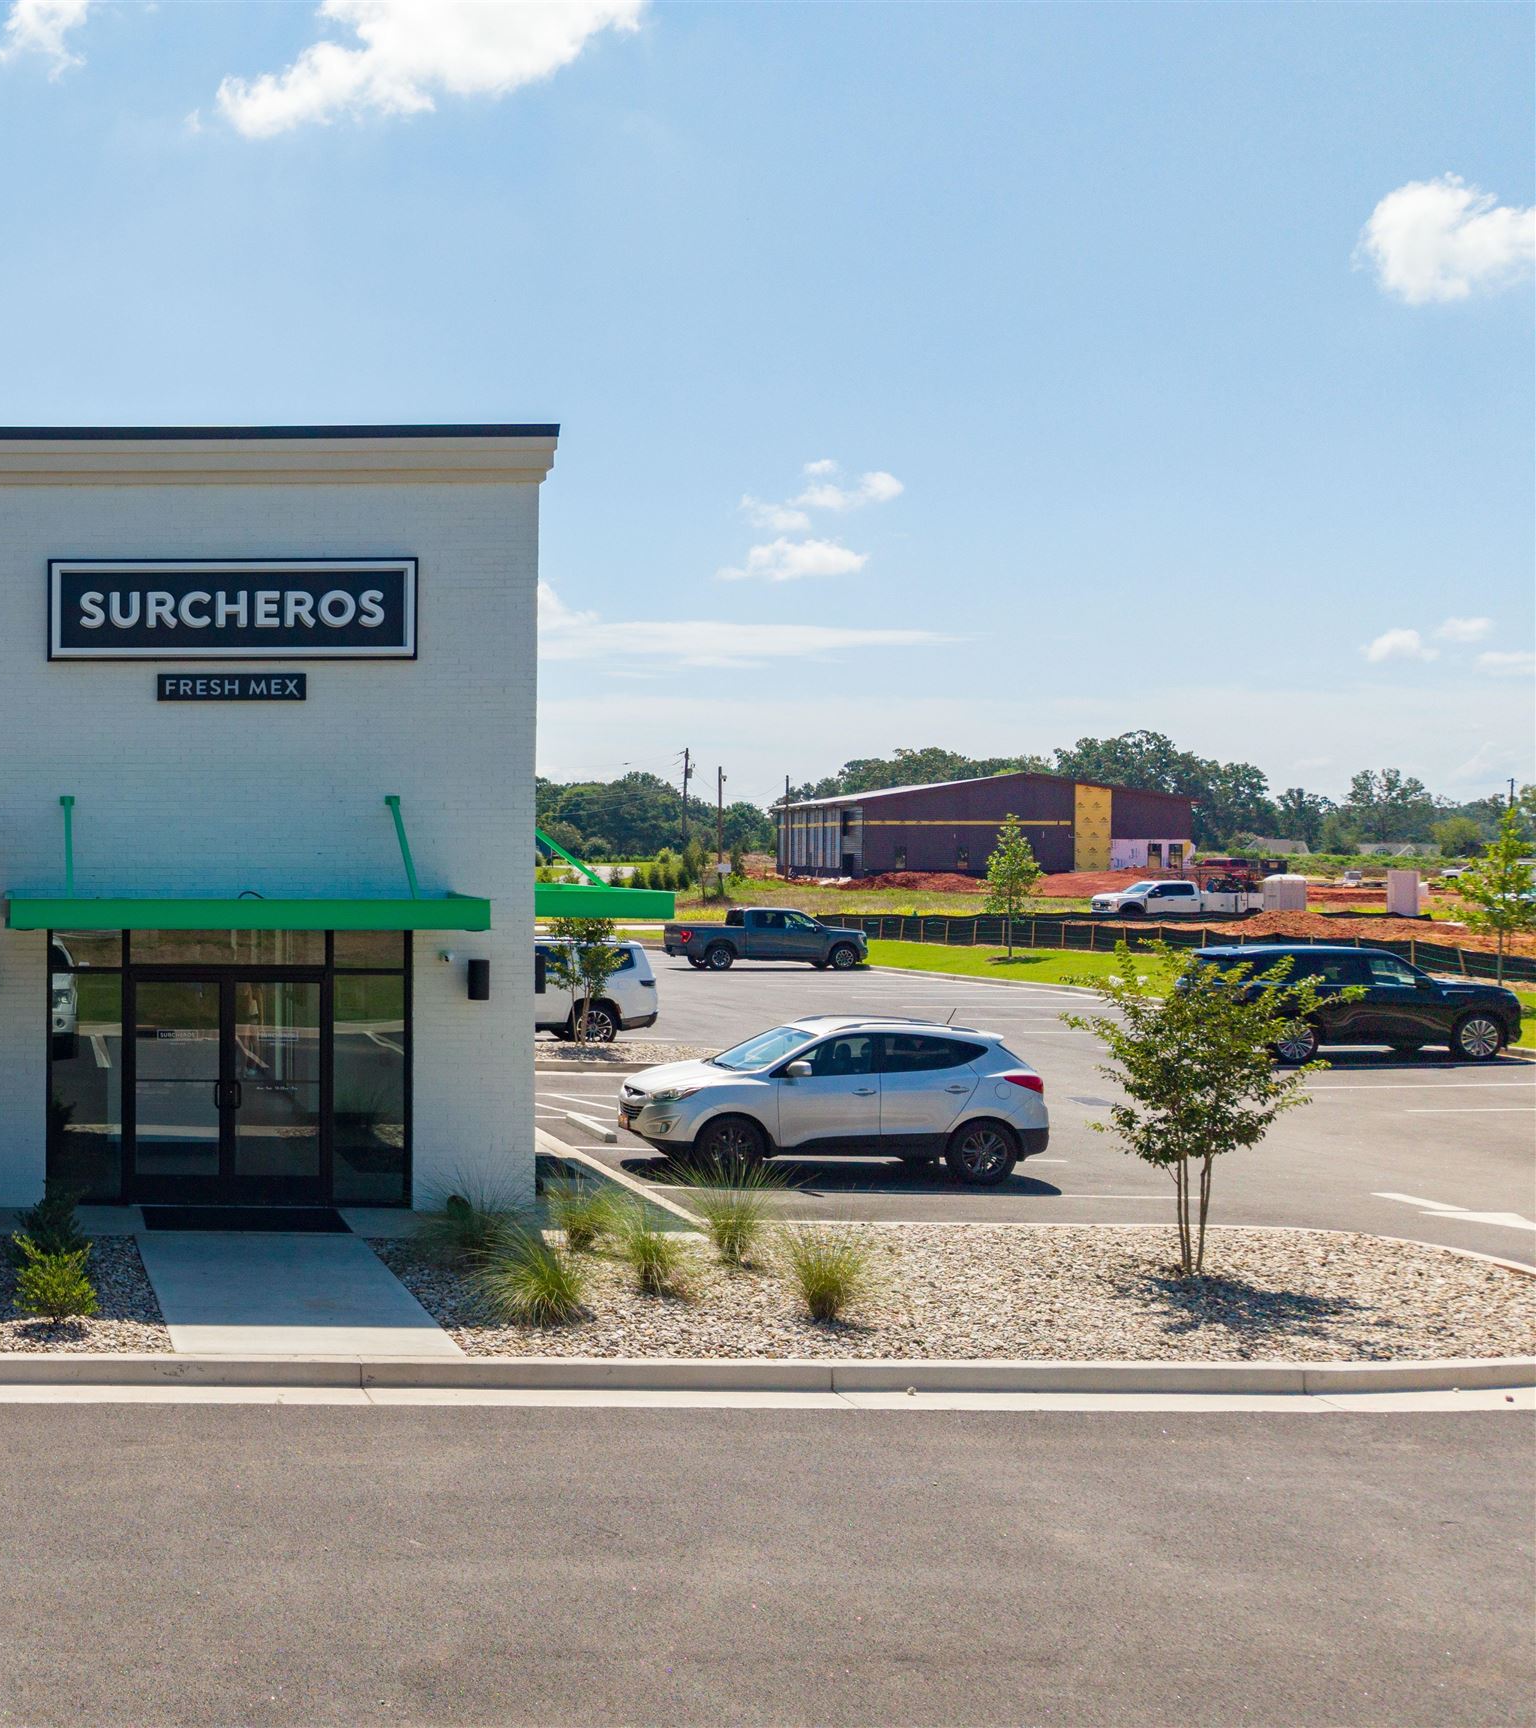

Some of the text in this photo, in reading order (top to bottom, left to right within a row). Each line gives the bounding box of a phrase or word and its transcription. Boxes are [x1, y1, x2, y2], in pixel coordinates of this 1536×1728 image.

[79, 590, 385, 629] SURCHEROS
[165, 679, 300, 698] FRESH MEX
